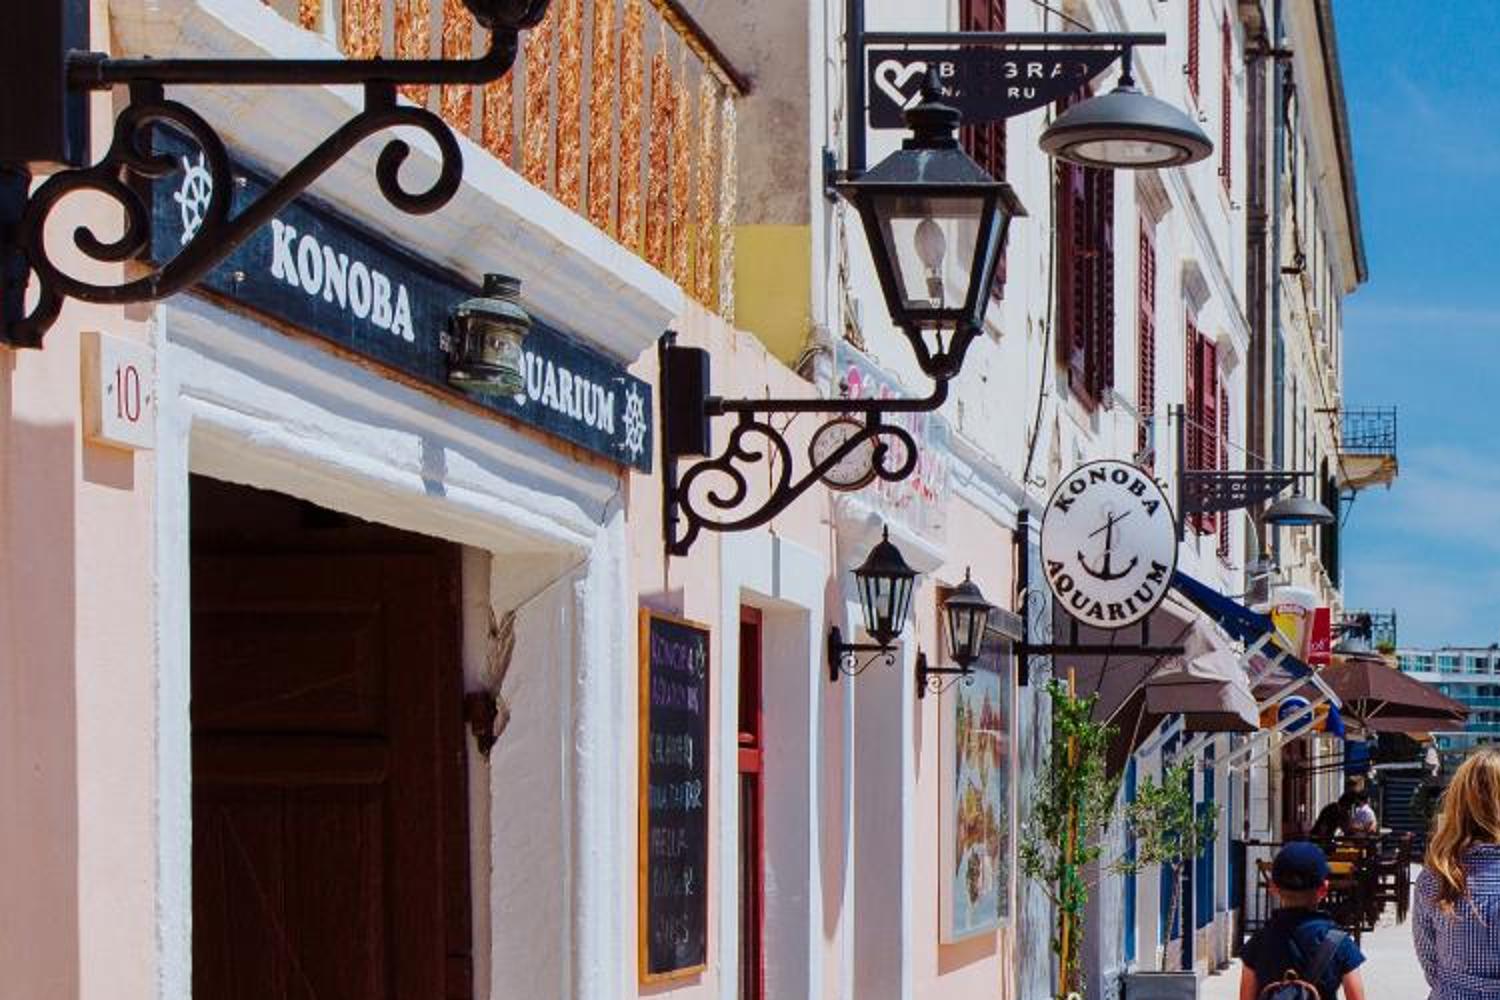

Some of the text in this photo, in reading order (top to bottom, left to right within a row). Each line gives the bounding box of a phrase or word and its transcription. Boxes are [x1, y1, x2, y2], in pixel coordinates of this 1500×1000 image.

[271, 218, 415, 343] KONOBA
[115, 364, 140, 423] 10
[1054, 467, 1160, 519] KONOBA
[1047, 559, 1168, 621] AQUARIUM
